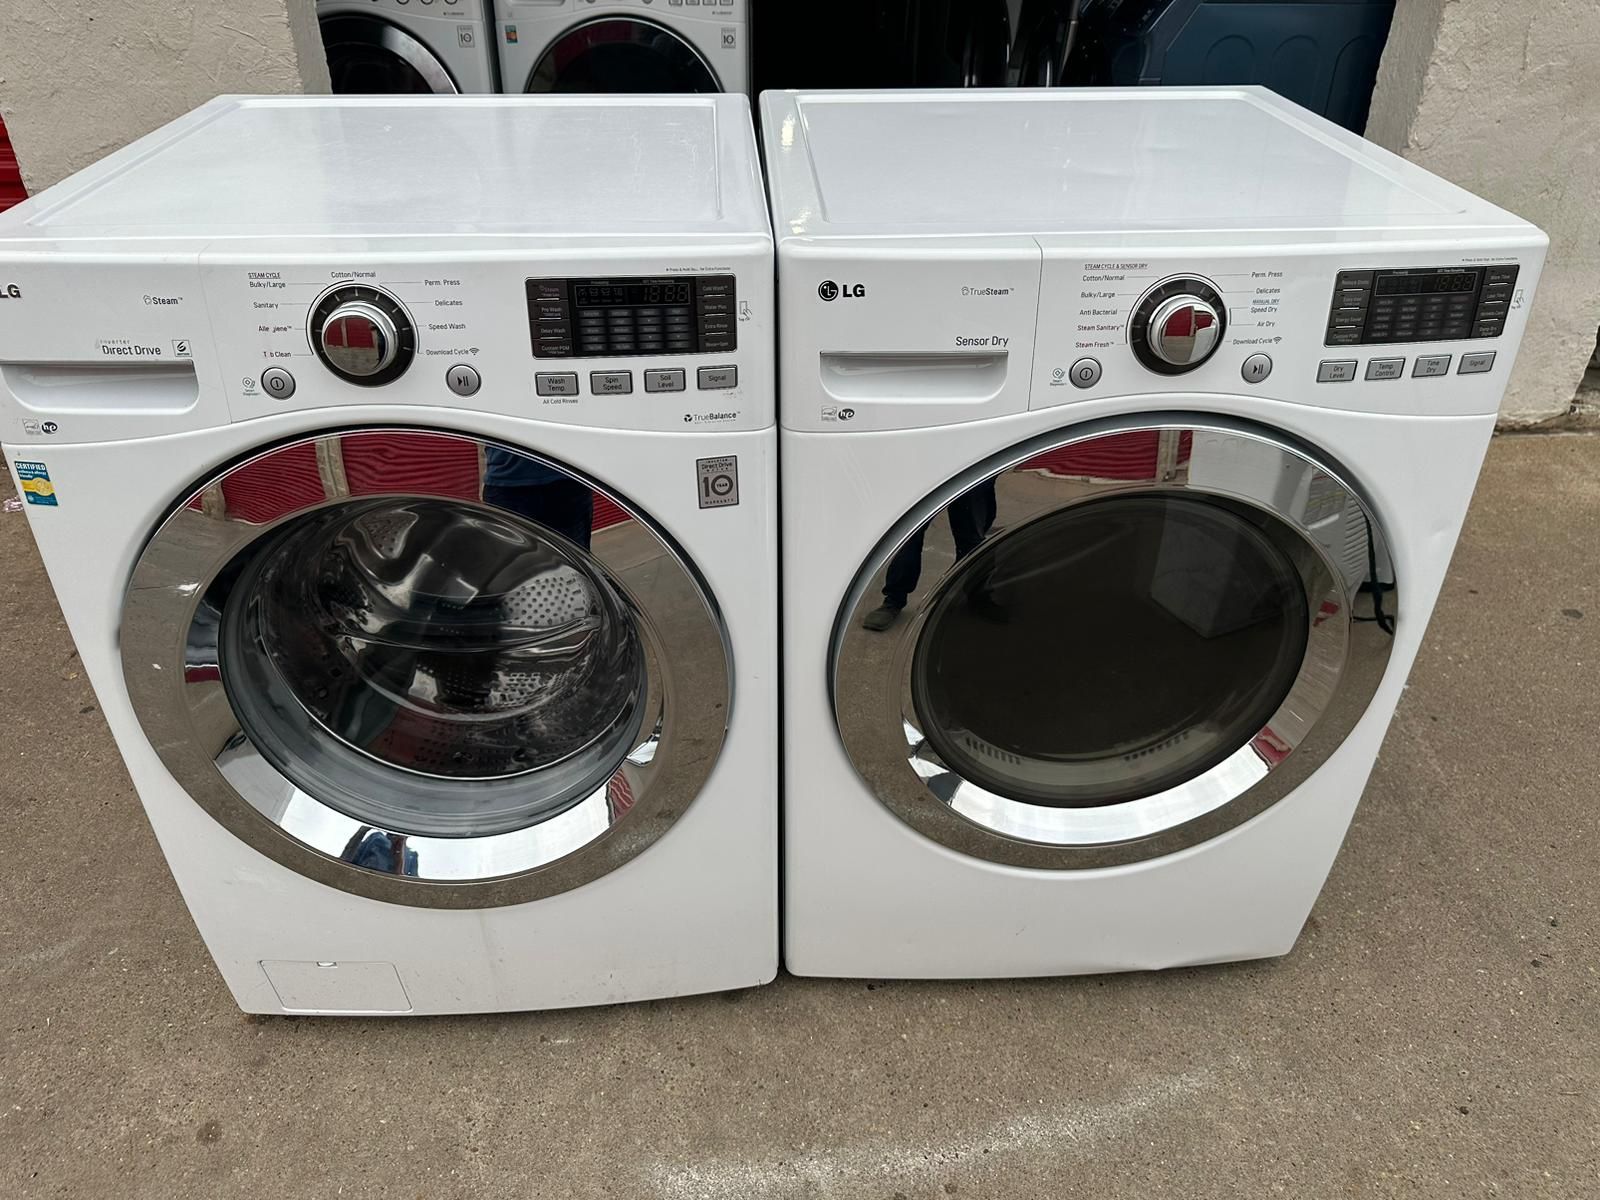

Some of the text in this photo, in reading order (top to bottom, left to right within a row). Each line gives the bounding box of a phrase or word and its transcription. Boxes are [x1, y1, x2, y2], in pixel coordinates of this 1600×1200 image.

[249, 281, 286, 289] Bulky/Large
[842, 283, 866, 298] LG
[1250, 306, 1267, 314] Speed
[955, 336, 1009, 347] Sensor Dry
[1232, 337, 1258, 345] Download
[102, 345, 161, 355] Direct Drive
[1378, 363, 1393, 371] Temp
[1468, 359, 1486, 367] Signal
[1333, 365, 1343, 373] Dry
[1374, 369, 1396, 377] Control
[605, 376, 619, 384] Spin
[708, 374, 726, 382] Signal
[548, 384, 565, 392] Temp
[602, 383, 622, 391] Speed
[16, 463, 46, 471] CERTIFIED
[703, 474, 734, 497] 10
